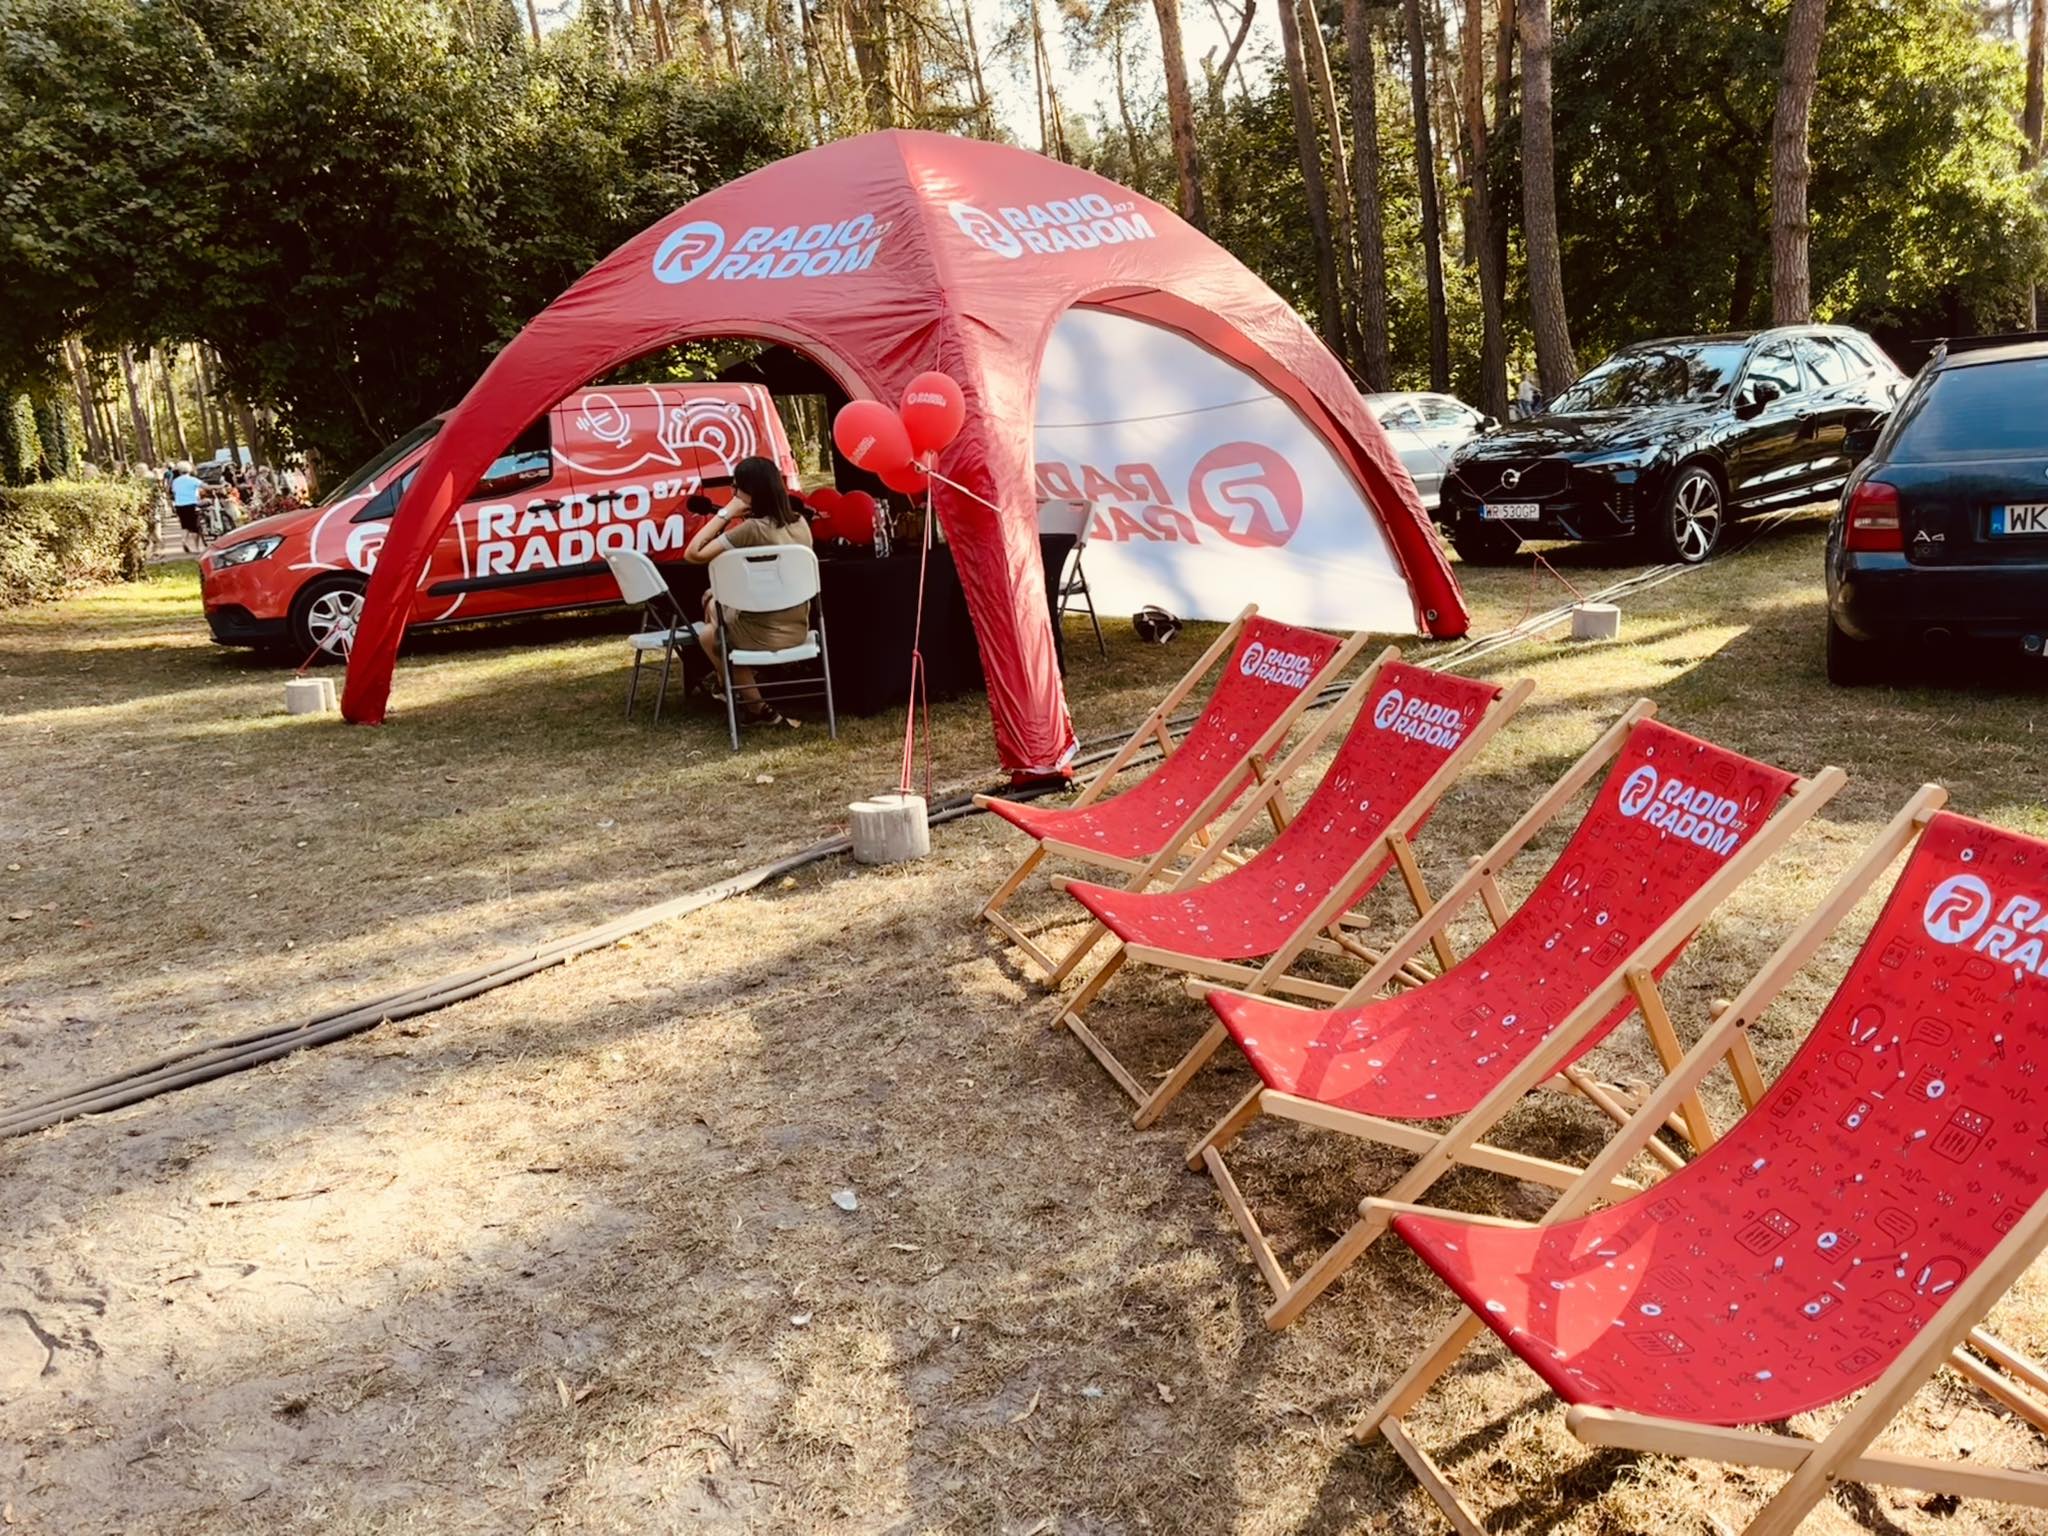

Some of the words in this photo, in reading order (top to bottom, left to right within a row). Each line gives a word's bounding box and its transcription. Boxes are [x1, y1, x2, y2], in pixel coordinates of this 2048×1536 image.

[998, 193, 1114, 230] RADIO
[731, 213, 875, 252] RADIO
[1019, 213, 1157, 254] RADOM
[707, 239, 884, 280] RADOM
[477, 485, 651, 542] RADIO
[652, 475, 702, 500] 87.7
[476, 514, 685, 578] RADOM
[1913, 530, 1945, 543] A4
[1255, 662, 1309, 689] RADOM
[1264, 648, 1310, 672] RADIO
[1392, 715, 1461, 750] RADOM
[1403, 698, 1460, 729] RADIO
[1658, 778, 1739, 825] RADIO
[1642, 800, 1740, 856] RADOM
[1973, 925, 2048, 978] RA
